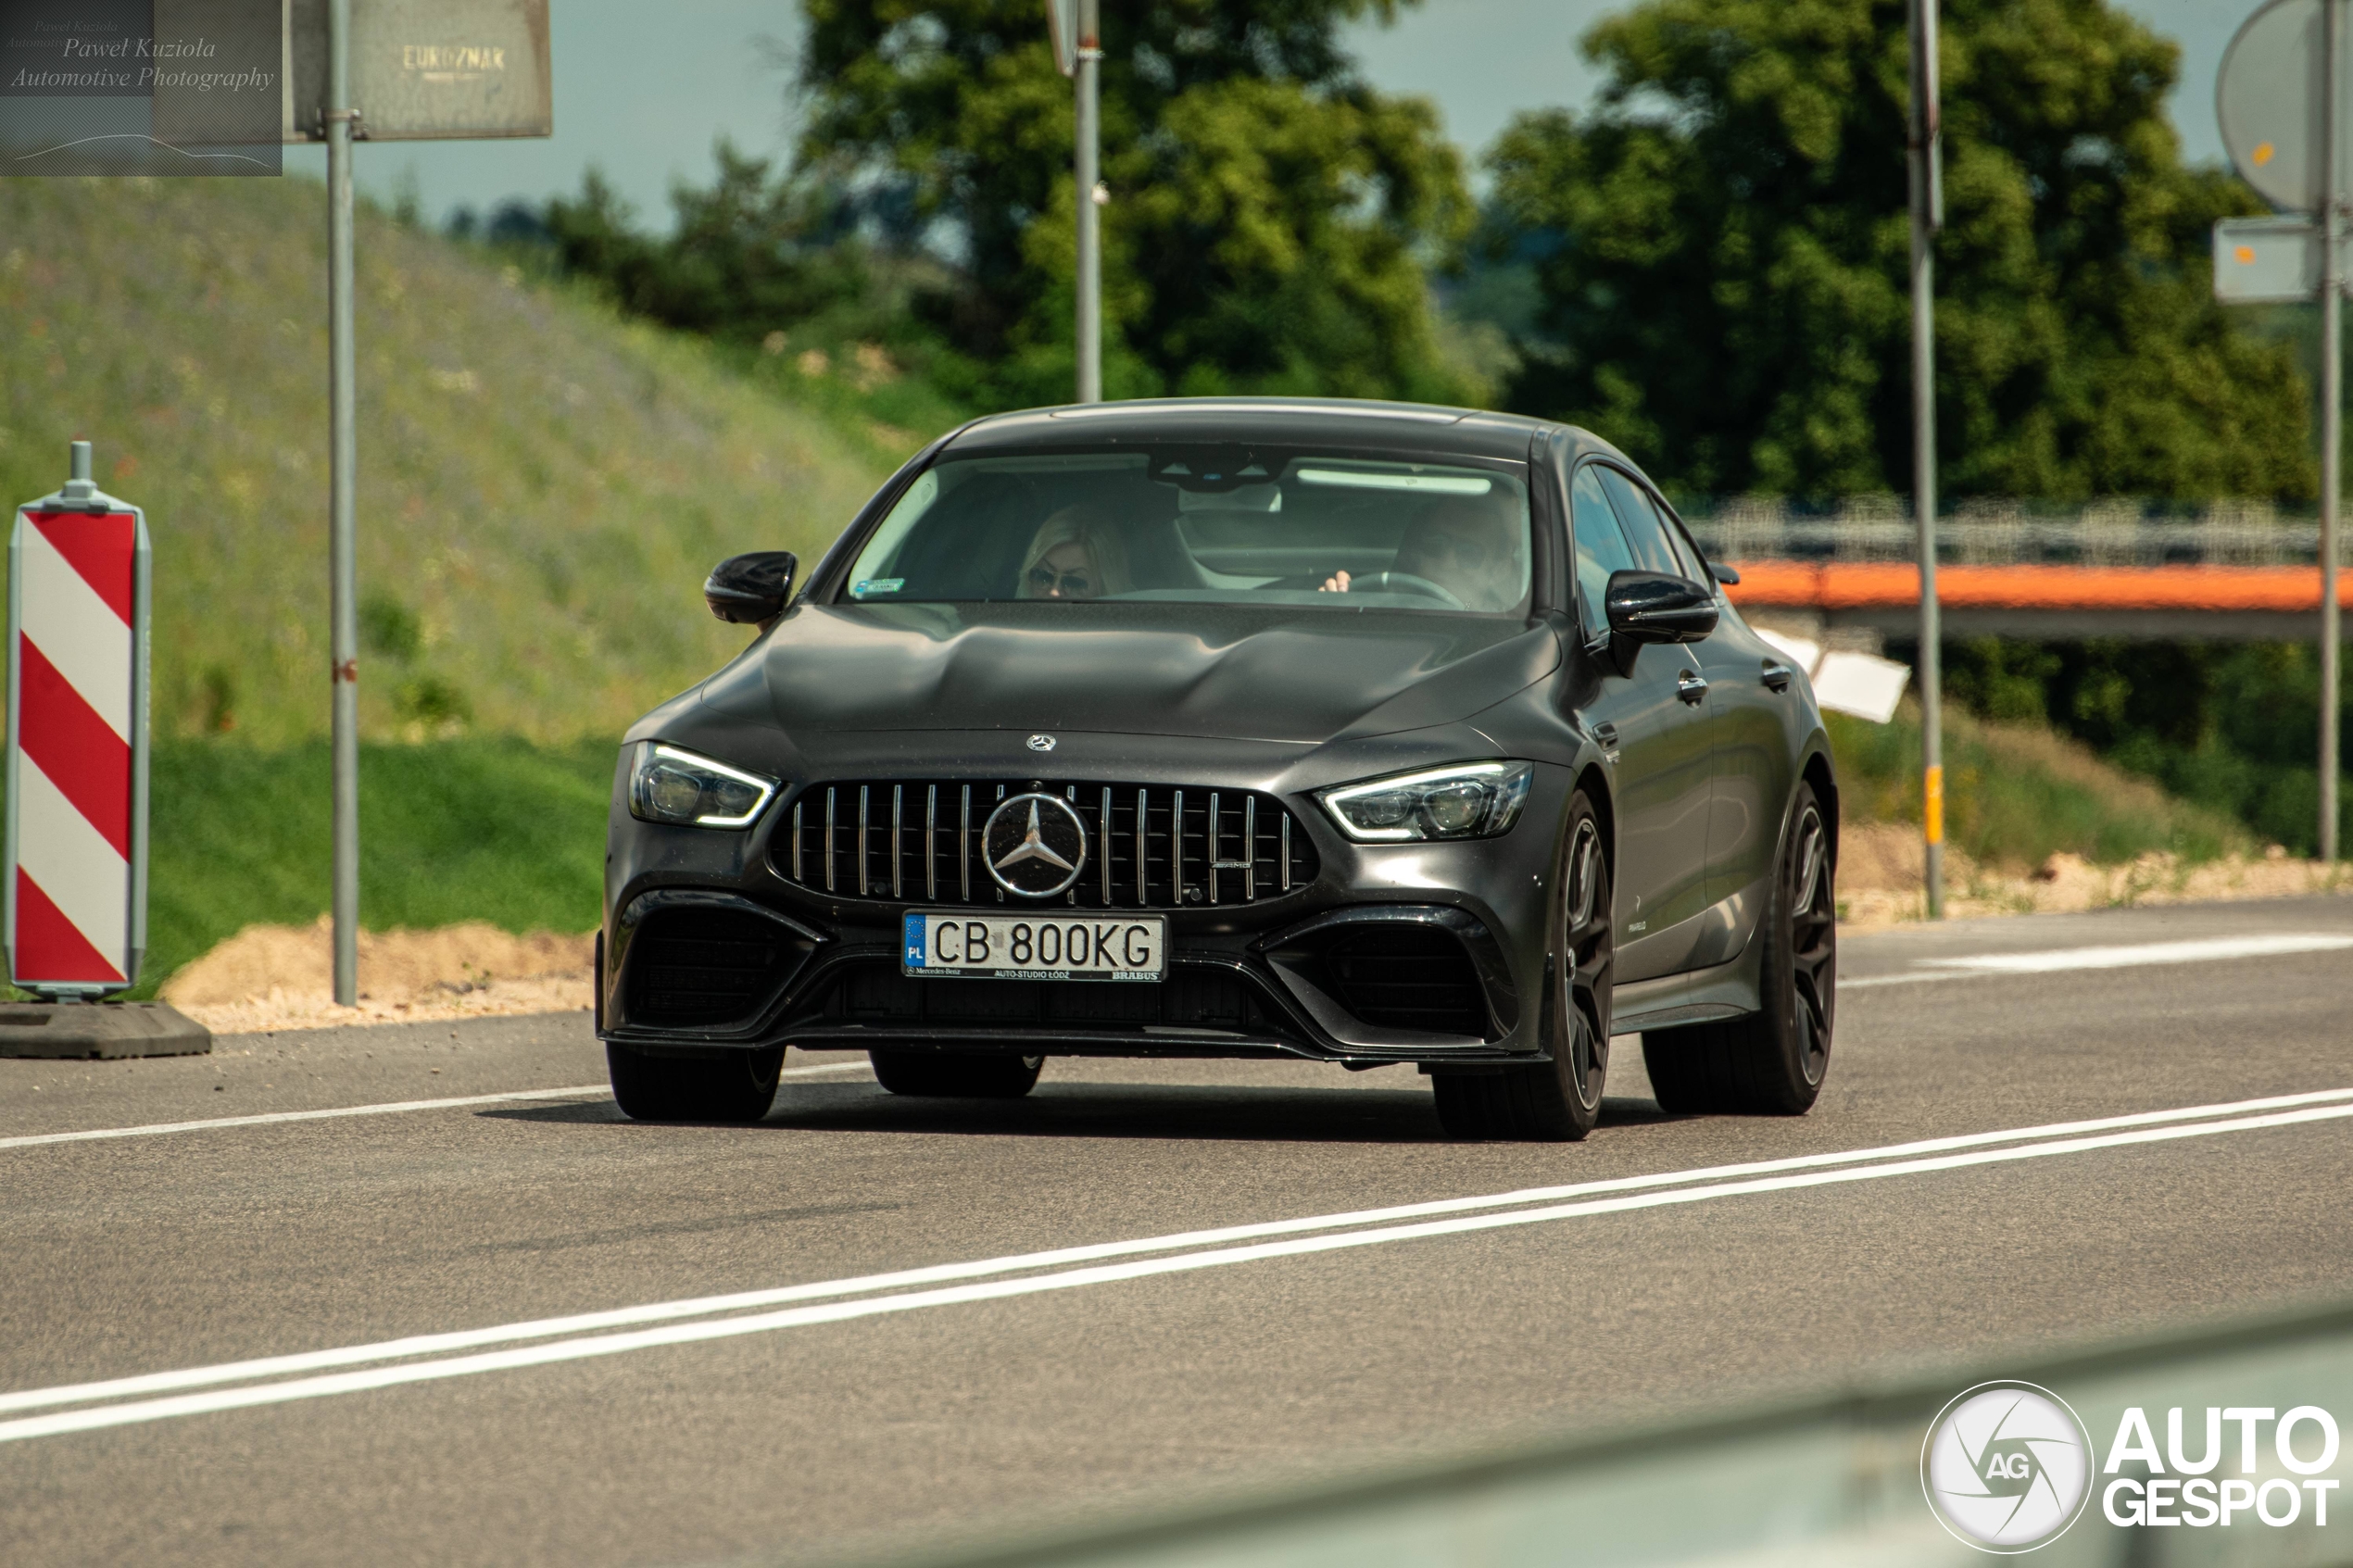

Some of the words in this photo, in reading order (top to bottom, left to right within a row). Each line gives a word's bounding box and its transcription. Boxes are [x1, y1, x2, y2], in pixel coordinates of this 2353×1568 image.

[936, 921, 989, 963] CB
[1011, 922, 1151, 967] 800KG
[908, 947, 924, 960] PL
[915, 967, 961, 975] Mercedes-Benz
[994, 970, 1047, 979] AUTO-STUDIO
[1112, 972, 1158, 981] BRABUS
